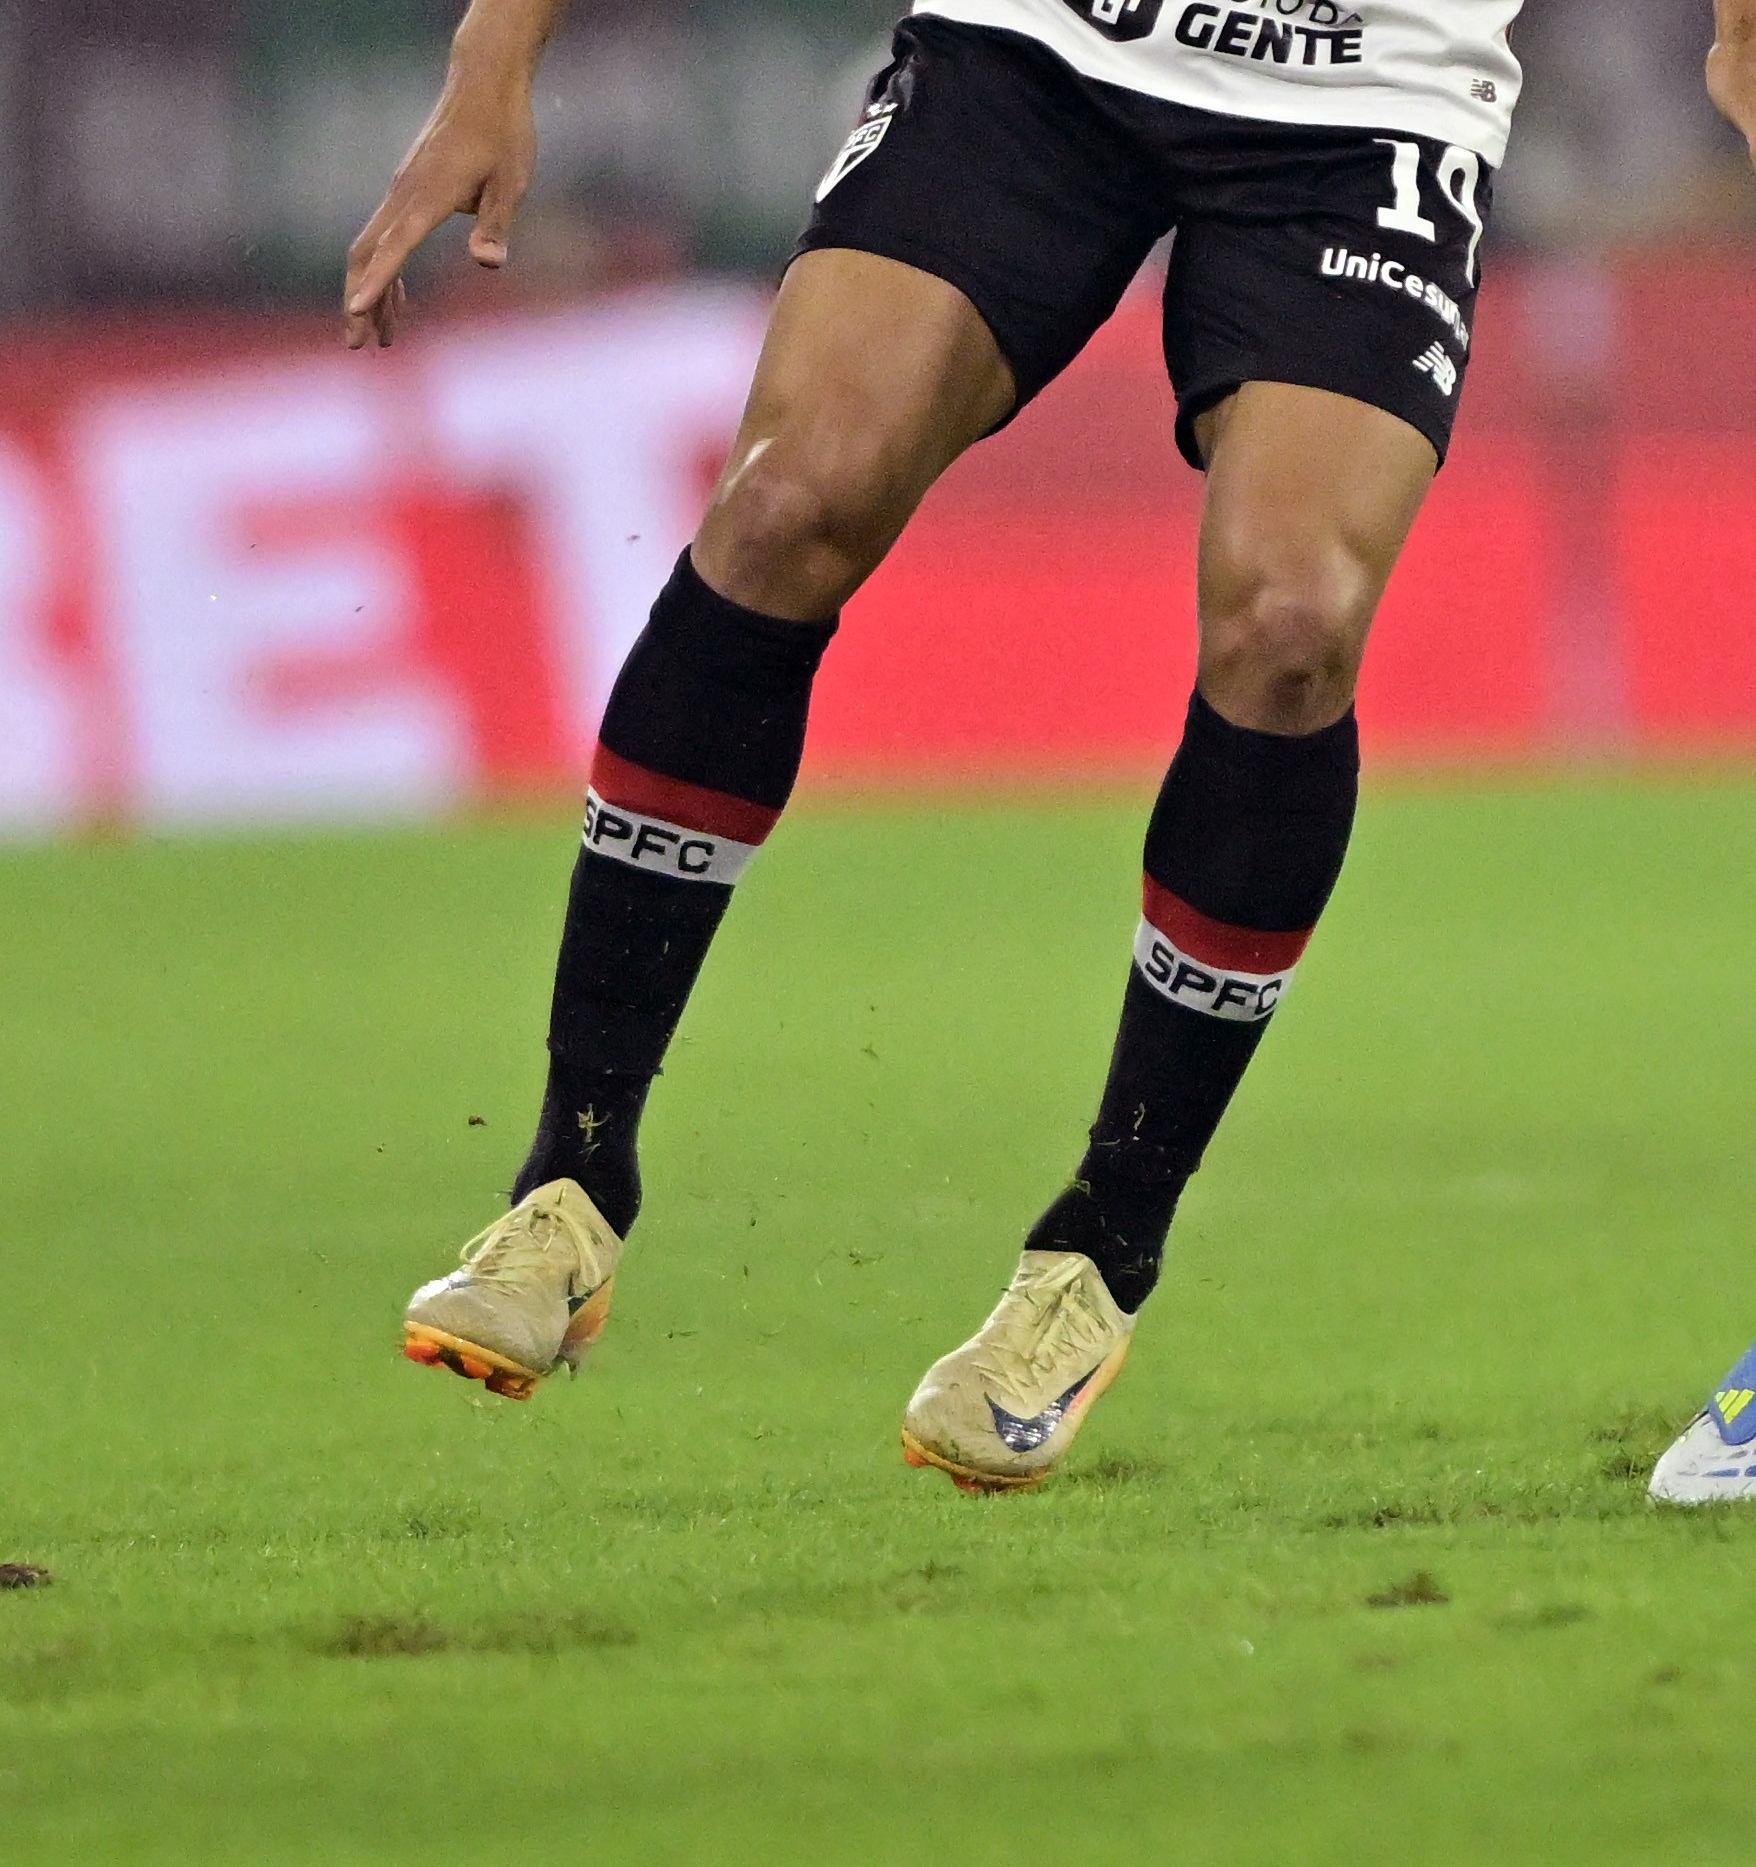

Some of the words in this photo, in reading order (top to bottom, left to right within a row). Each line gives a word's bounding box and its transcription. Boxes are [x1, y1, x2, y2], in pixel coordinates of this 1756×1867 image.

[1174, 2, 1364, 65] GENTE
[1372, 137, 1484, 289] 19
[0, 278, 778, 818] ET
[1145, 940, 1283, 1016] SPFC
